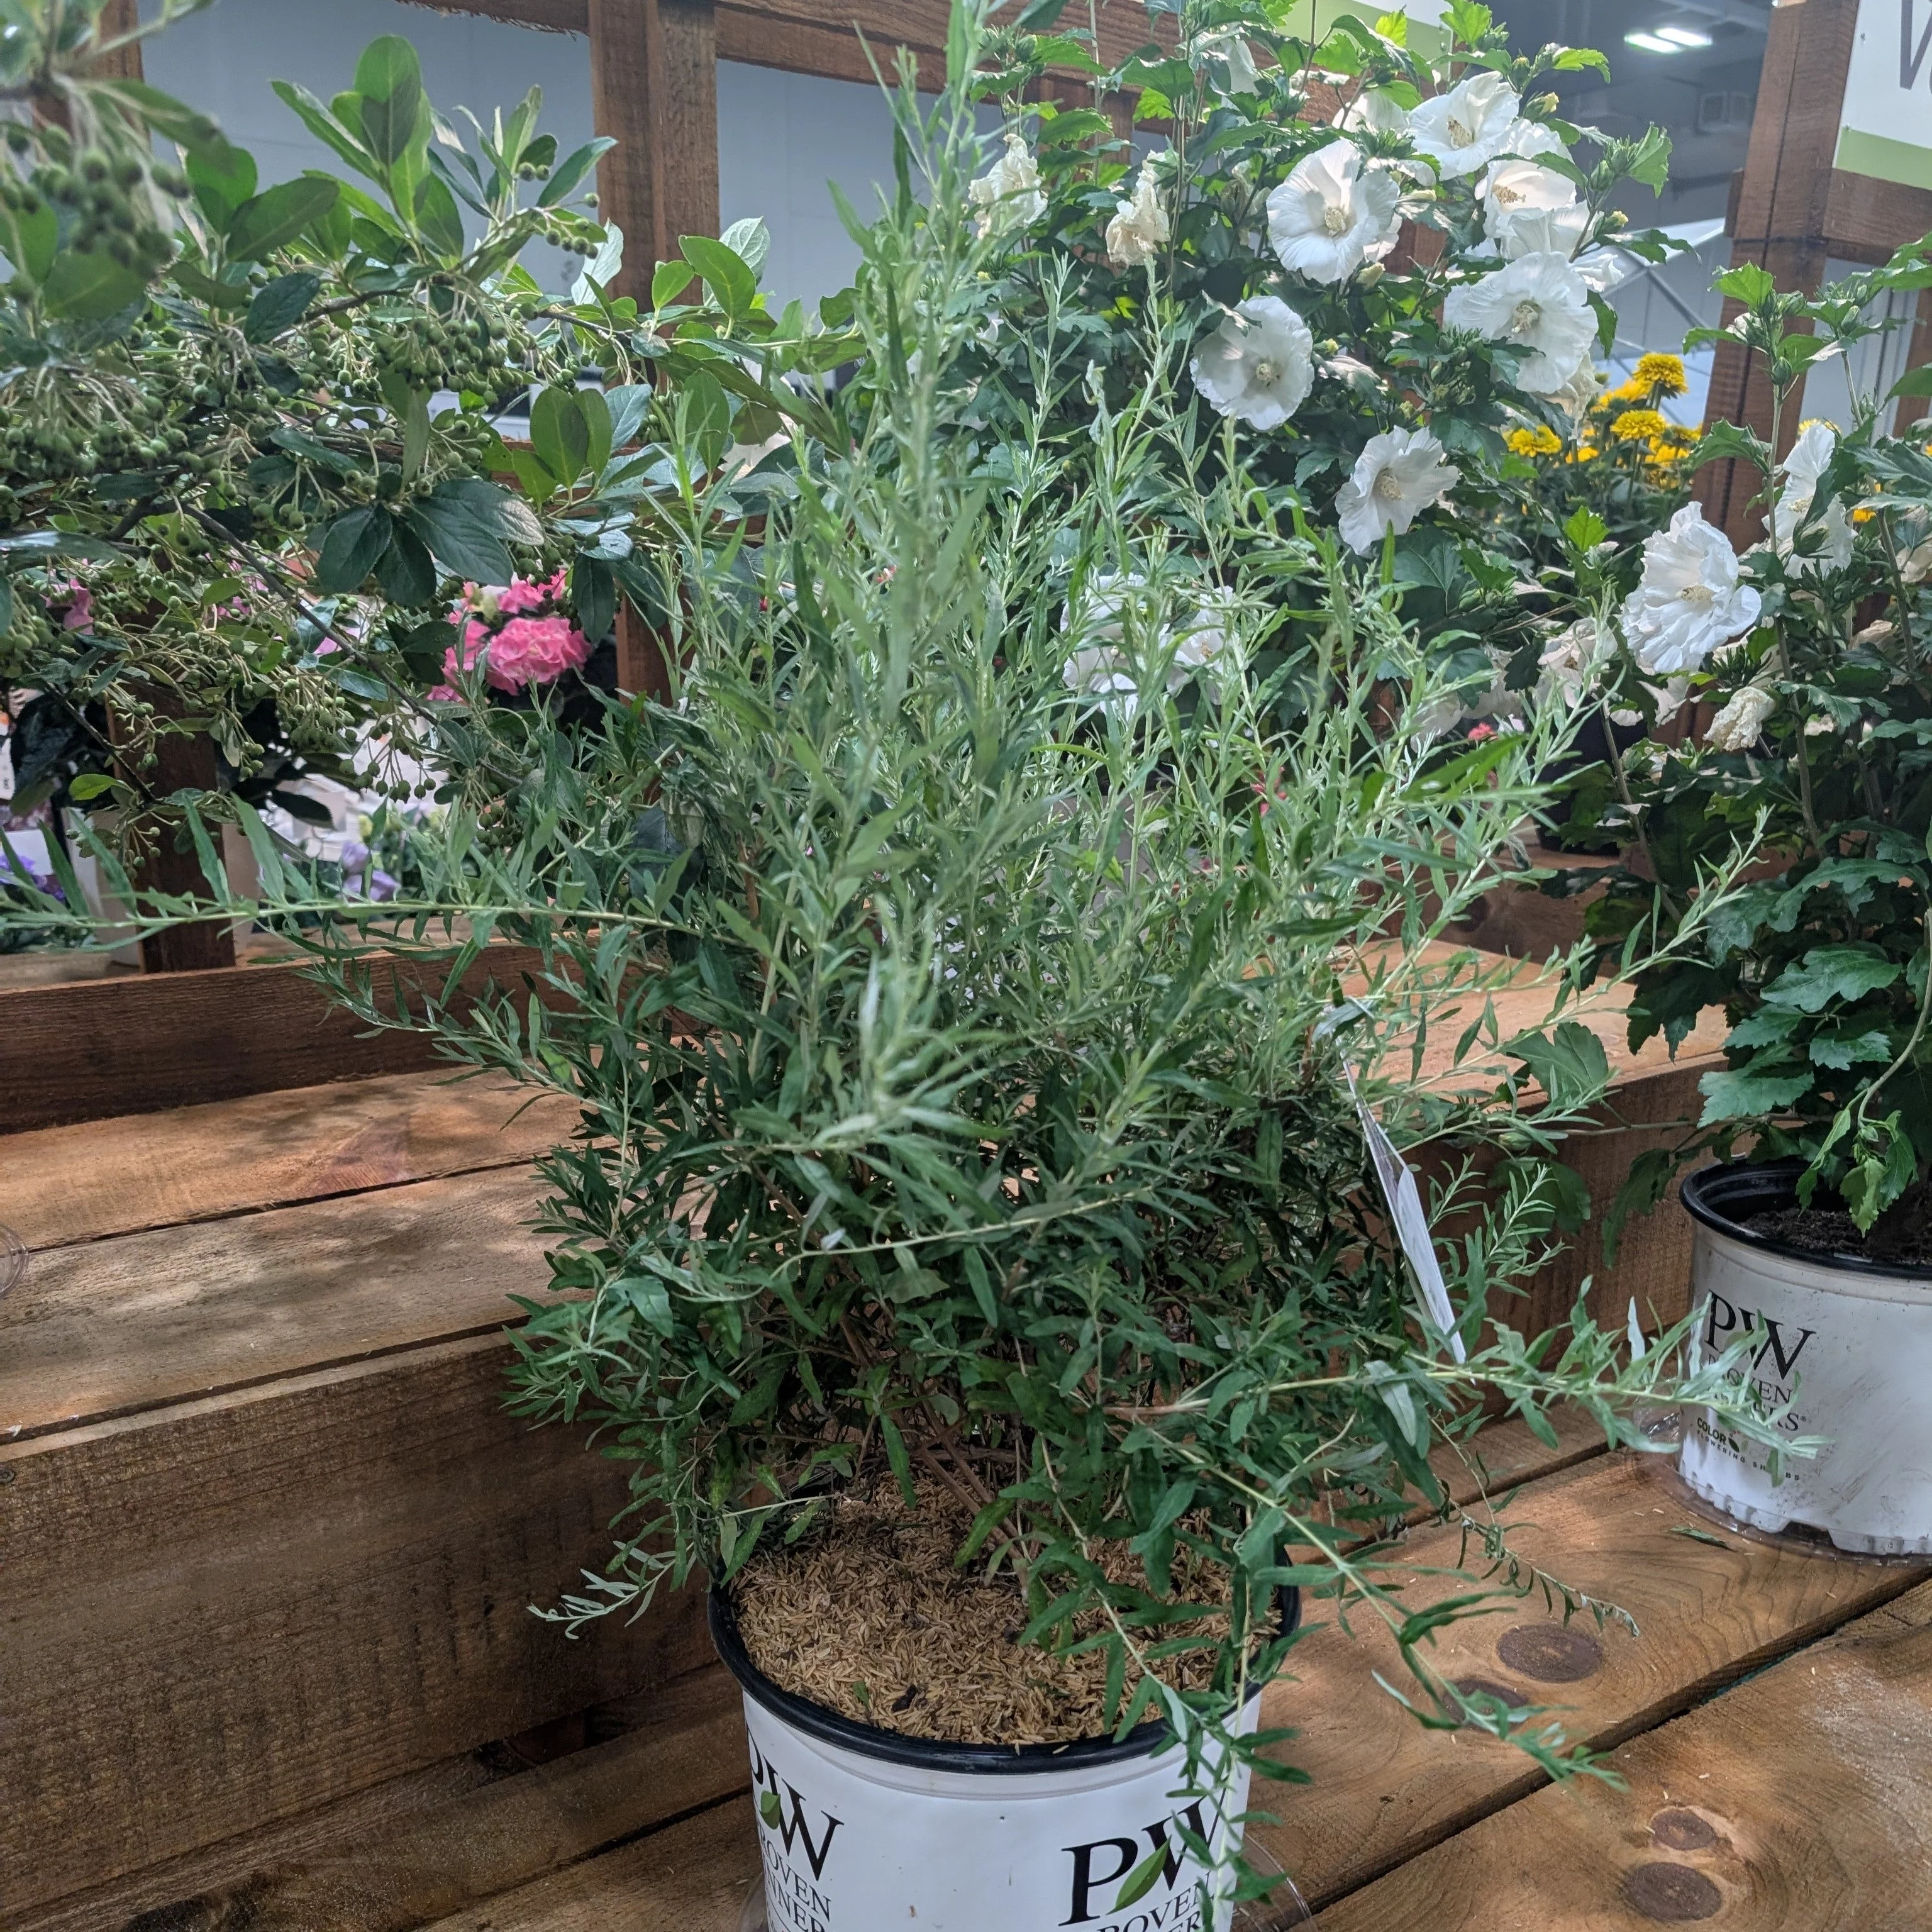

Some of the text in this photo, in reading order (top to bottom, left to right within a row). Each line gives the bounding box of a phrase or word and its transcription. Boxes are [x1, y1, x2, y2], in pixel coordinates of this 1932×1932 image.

[1704, 1289, 1816, 1380] PW
[1708, 1354, 1793, 1404] POEN
[1697, 1417, 1728, 1446] COLOR
[1697, 1430, 1800, 1481] FLOWERING SHBS
[759, 1821, 832, 1923] ROVEN
[1058, 1775, 1229, 1926] PW
[1097, 1870, 1211, 1932] OVEN
